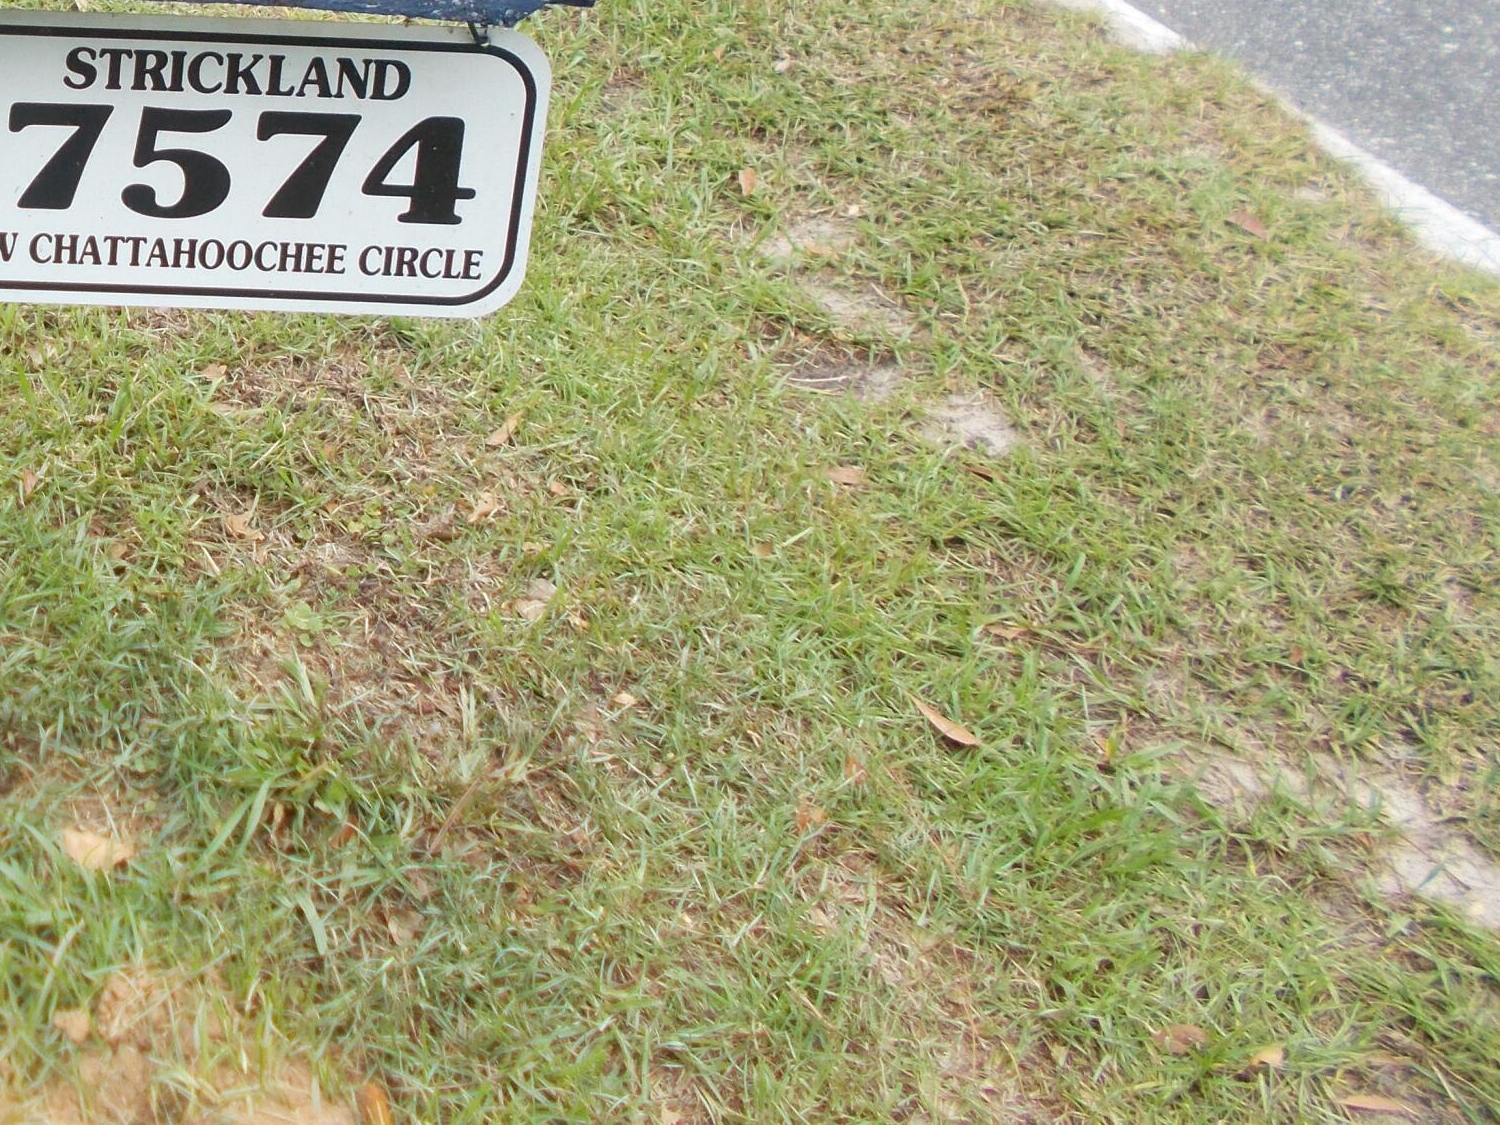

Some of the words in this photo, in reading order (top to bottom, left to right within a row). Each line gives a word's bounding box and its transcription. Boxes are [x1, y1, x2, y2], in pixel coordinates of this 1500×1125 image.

[63, 46, 412, 101] STRICKLAND
[8, 102, 476, 225] 7574
[28, 232, 348, 275] CHATTAHOOCHEE
[358, 245, 484, 280] CIRCLE
